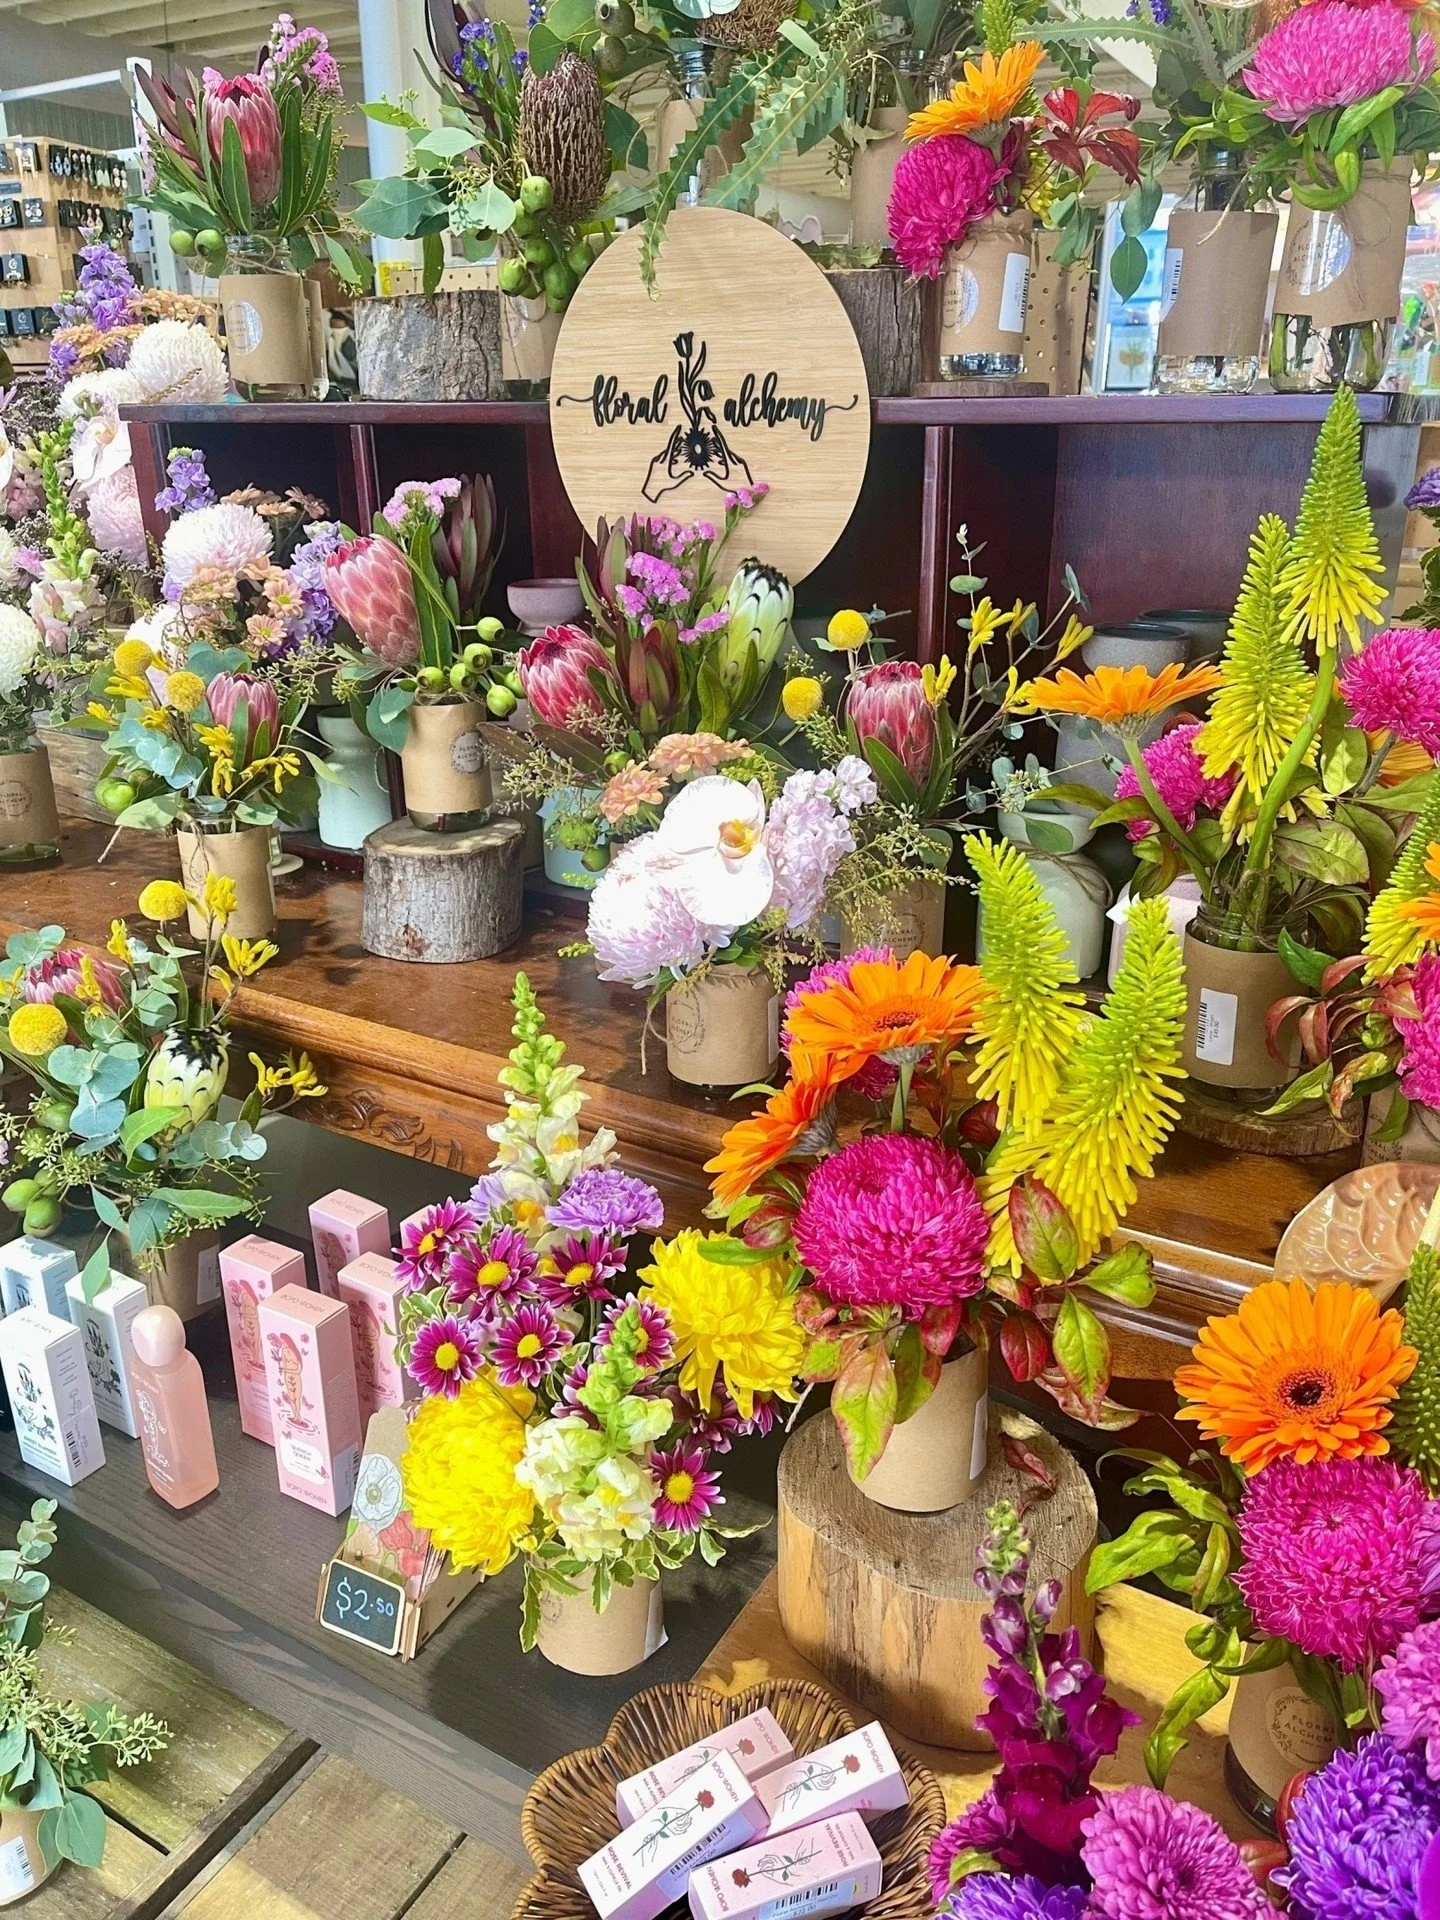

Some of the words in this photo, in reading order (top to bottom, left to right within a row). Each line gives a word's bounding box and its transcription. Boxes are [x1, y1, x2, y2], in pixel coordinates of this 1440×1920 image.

[555, 373, 669, 428] floral
[723, 371, 859, 441] alchemy
[862, 1731, 874, 1749] BOPO
[870, 1748, 884, 1773] WOMEN
[712, 1761, 725, 1779] BOPO
[722, 1777, 739, 1802] WOMEN
[824, 1823, 840, 1849] REVIVAL
[607, 1846, 620, 1864] ROSE
[616, 1862, 632, 1890] REVIVAL
[837, 1849, 850, 1868] ROSE
[706, 1866, 721, 1893] WOMEN
[718, 1892, 730, 1913] BOPO
